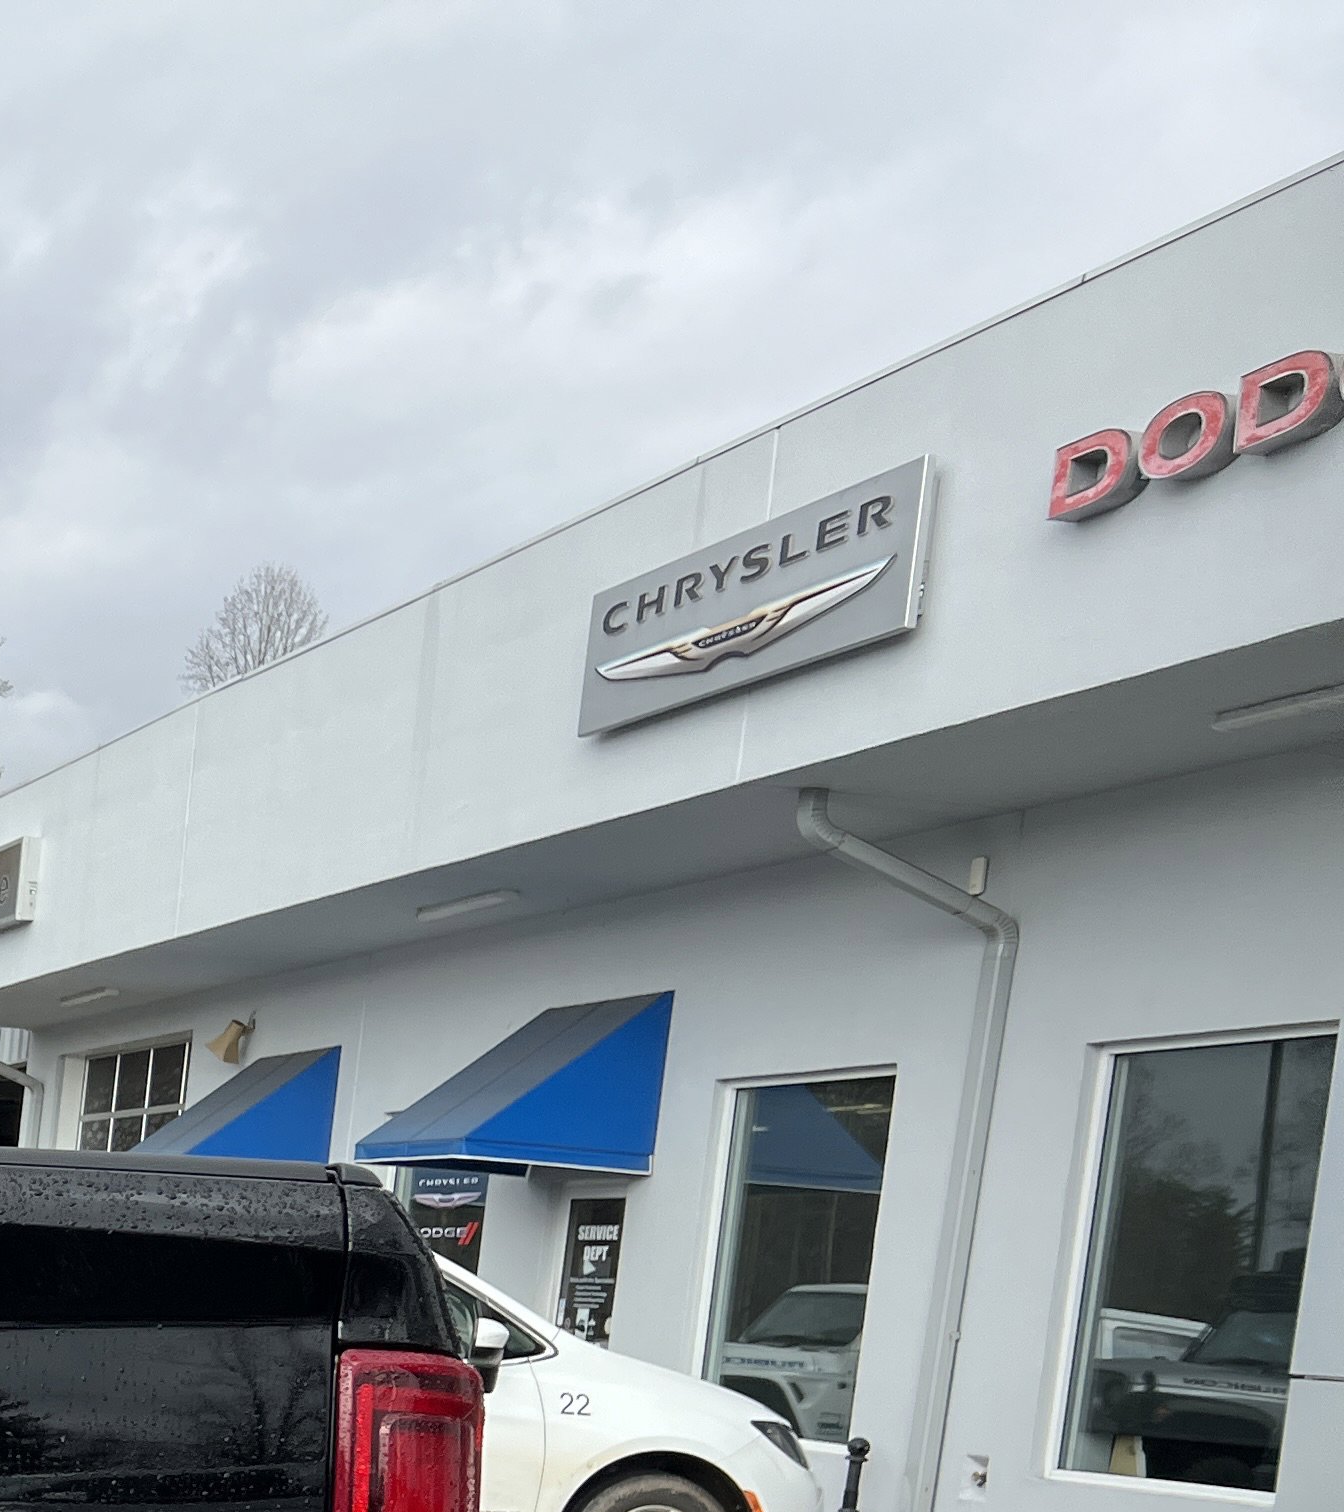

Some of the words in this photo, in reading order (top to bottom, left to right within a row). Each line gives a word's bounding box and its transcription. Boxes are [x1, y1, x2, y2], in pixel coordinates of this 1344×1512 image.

[1046, 348, 1344, 523] DOD
[602, 494, 896, 636] CHRYSLER
[419, 1226, 469, 1239] ODGE
[577, 1224, 620, 1241] SERVICE
[583, 1245, 609, 1262] DEPT
[559, 1392, 592, 1417] 22
